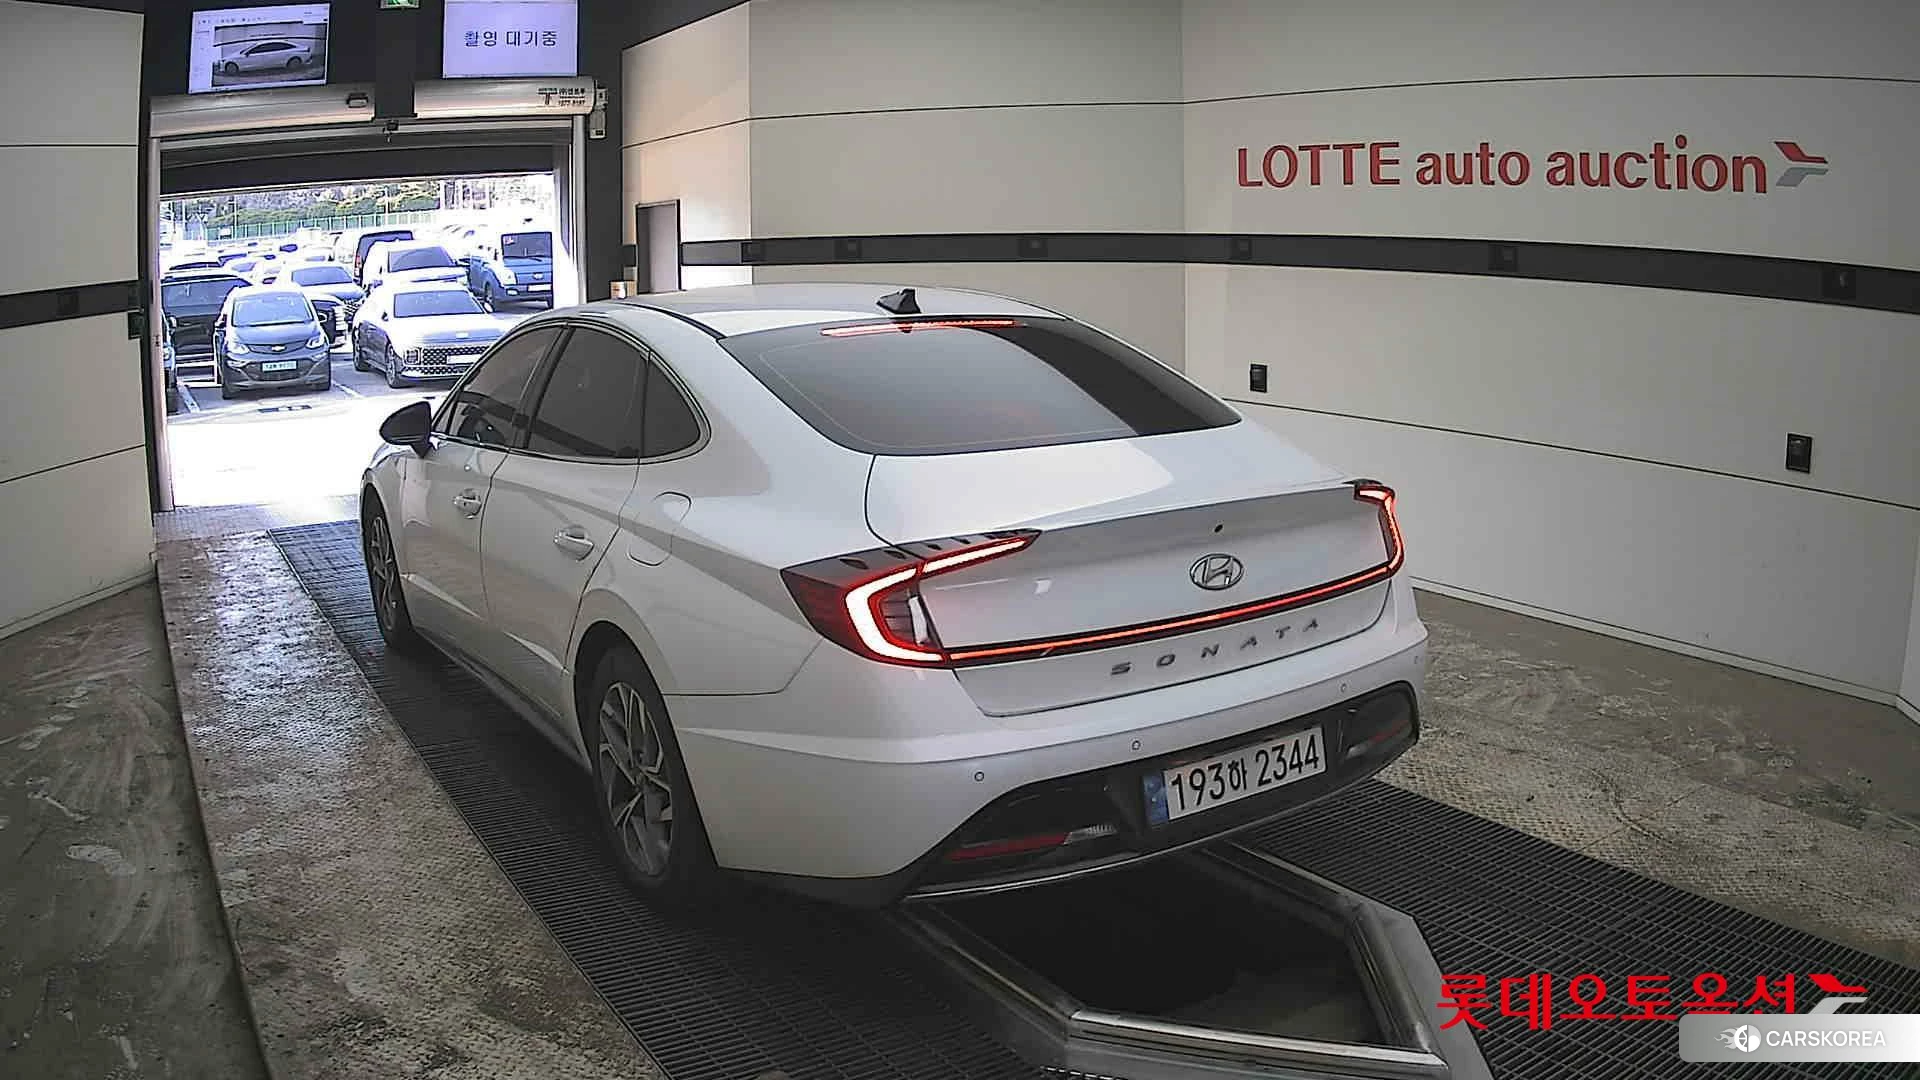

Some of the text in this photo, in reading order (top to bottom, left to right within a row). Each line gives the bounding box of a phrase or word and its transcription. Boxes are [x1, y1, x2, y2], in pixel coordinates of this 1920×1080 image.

[464, 31, 558, 48] 촬영 대기중
[1237, 136, 1766, 193] LOTTE auto auction
[1110, 619, 1319, 676] SONATA
[1171, 734, 1319, 810] 193하 2344
